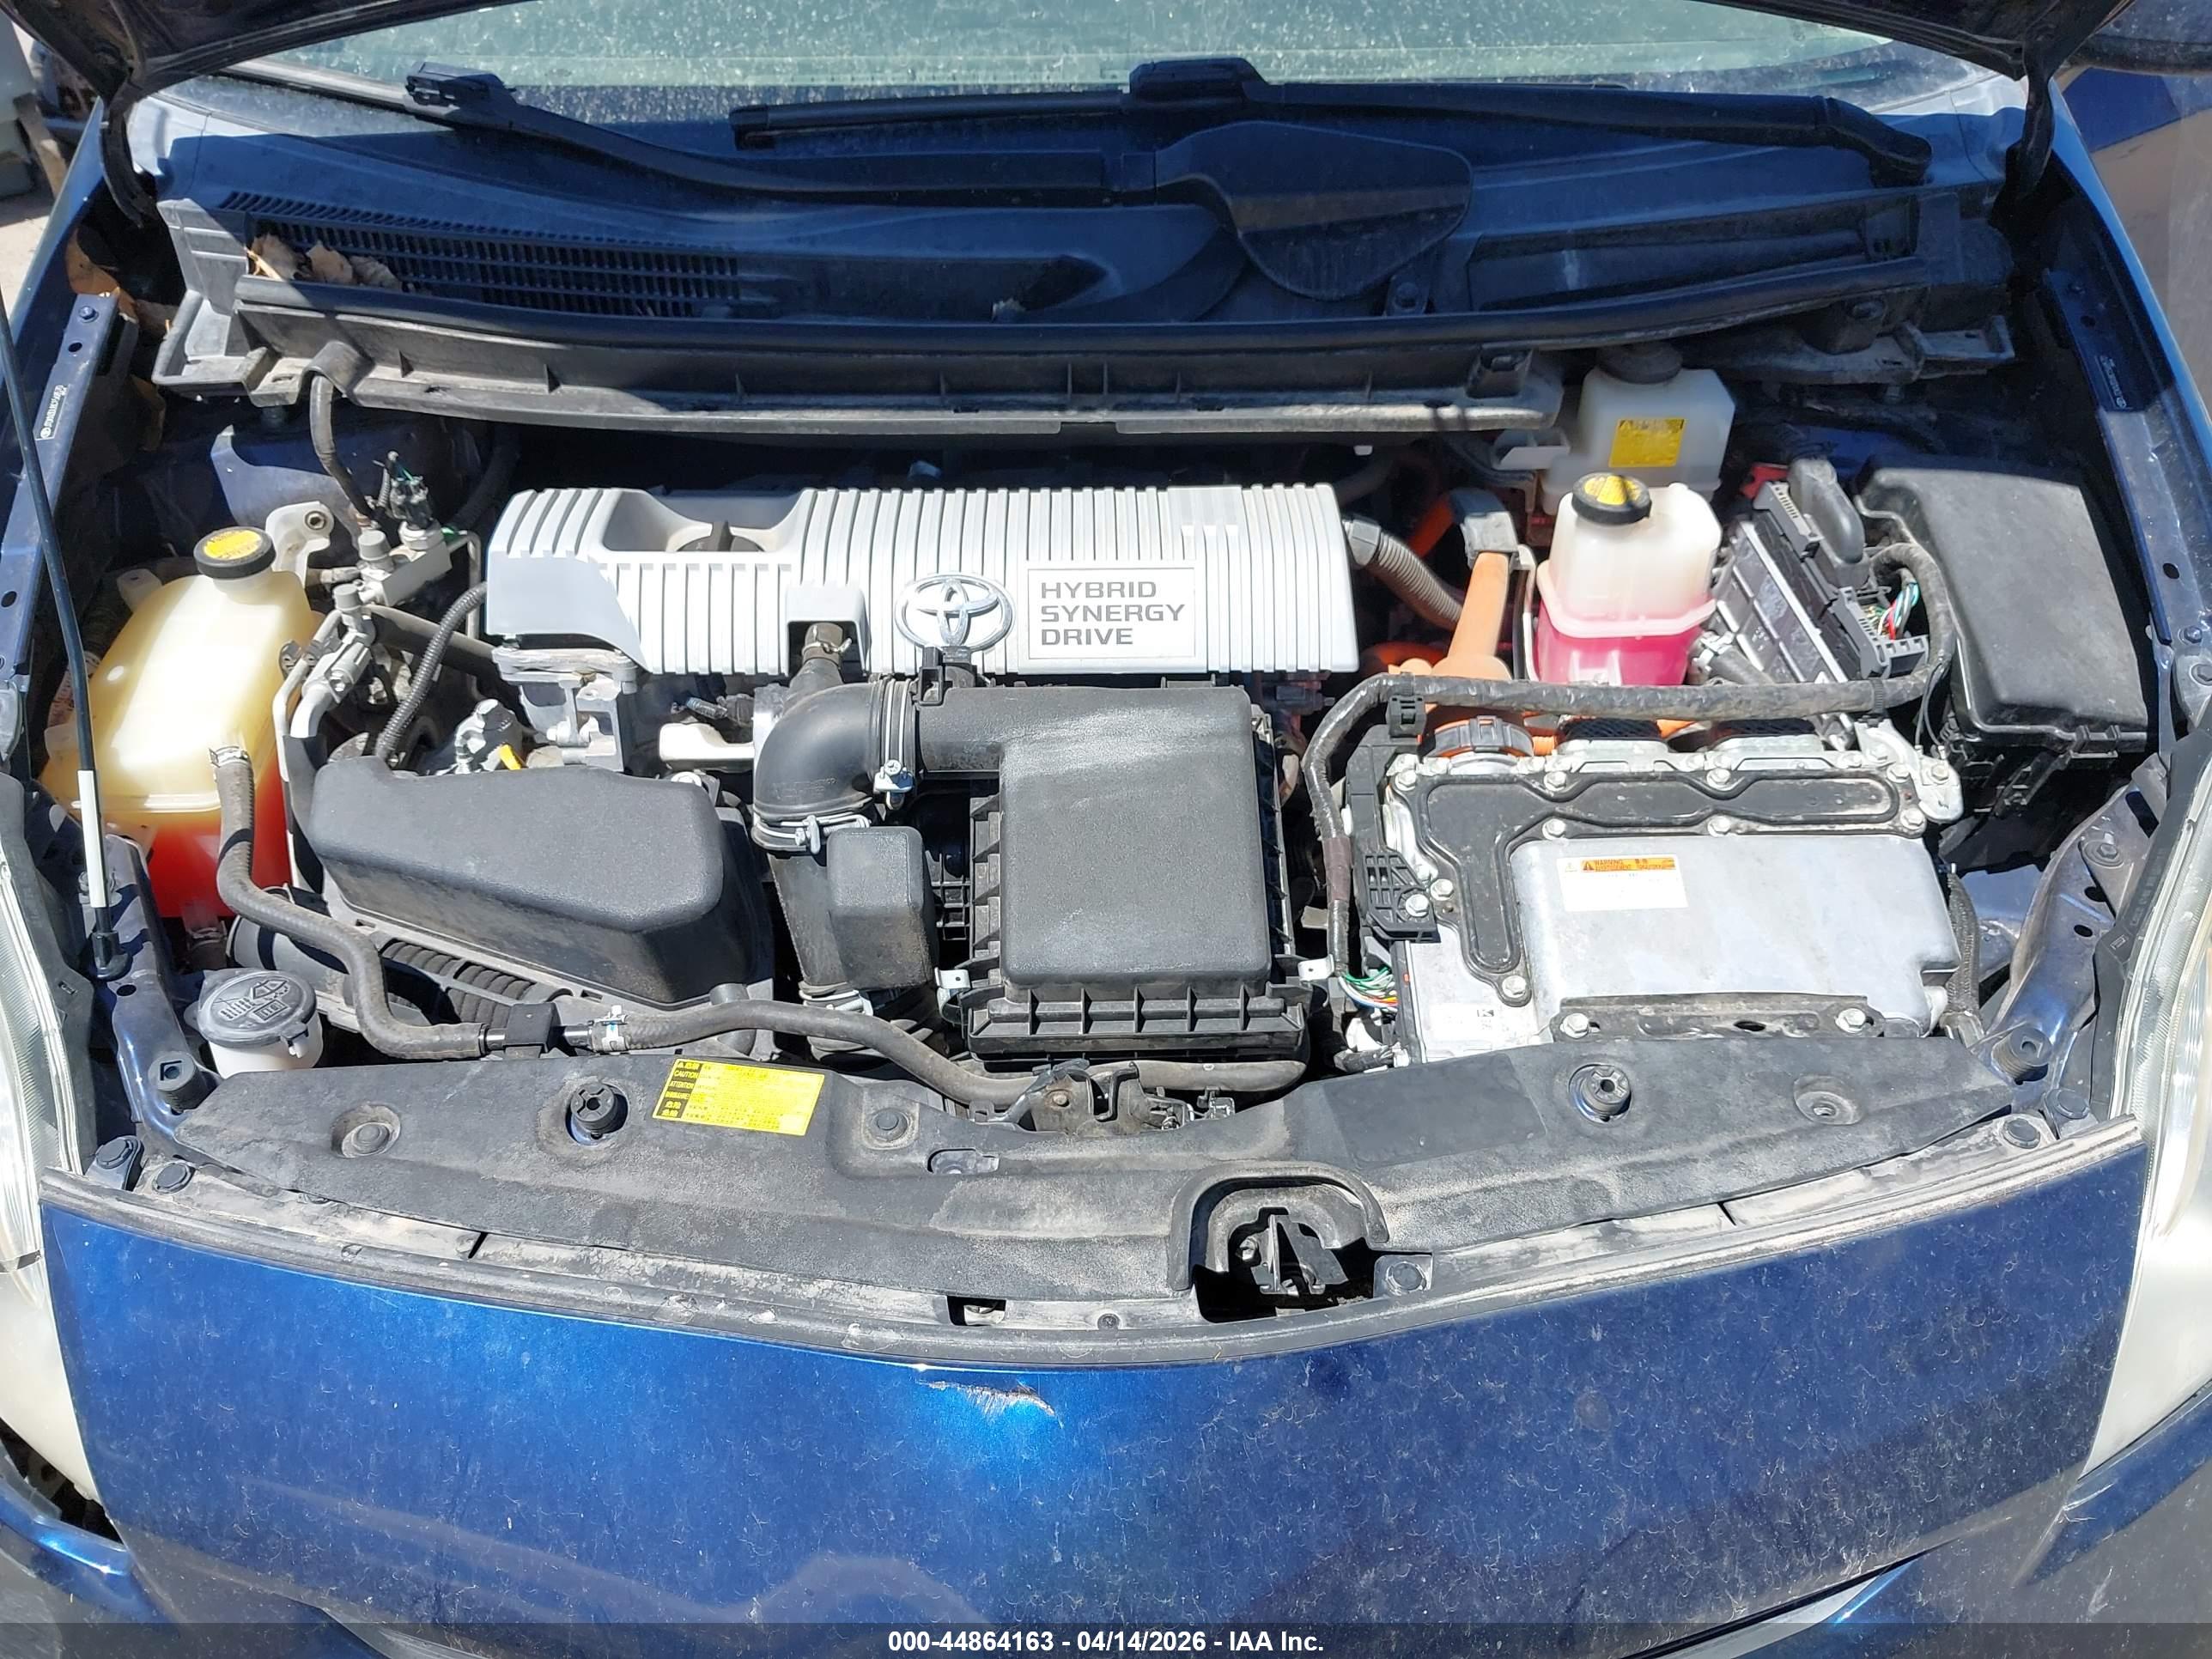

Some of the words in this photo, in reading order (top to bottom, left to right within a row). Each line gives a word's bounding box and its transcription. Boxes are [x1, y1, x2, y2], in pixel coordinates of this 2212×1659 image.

[1041, 581, 1157, 599] HYBRID
[1041, 604, 1185, 623] SYNERGY
[1041, 628, 1133, 646] DRIVE
[673, 1070, 699, 1079] CAUTION
